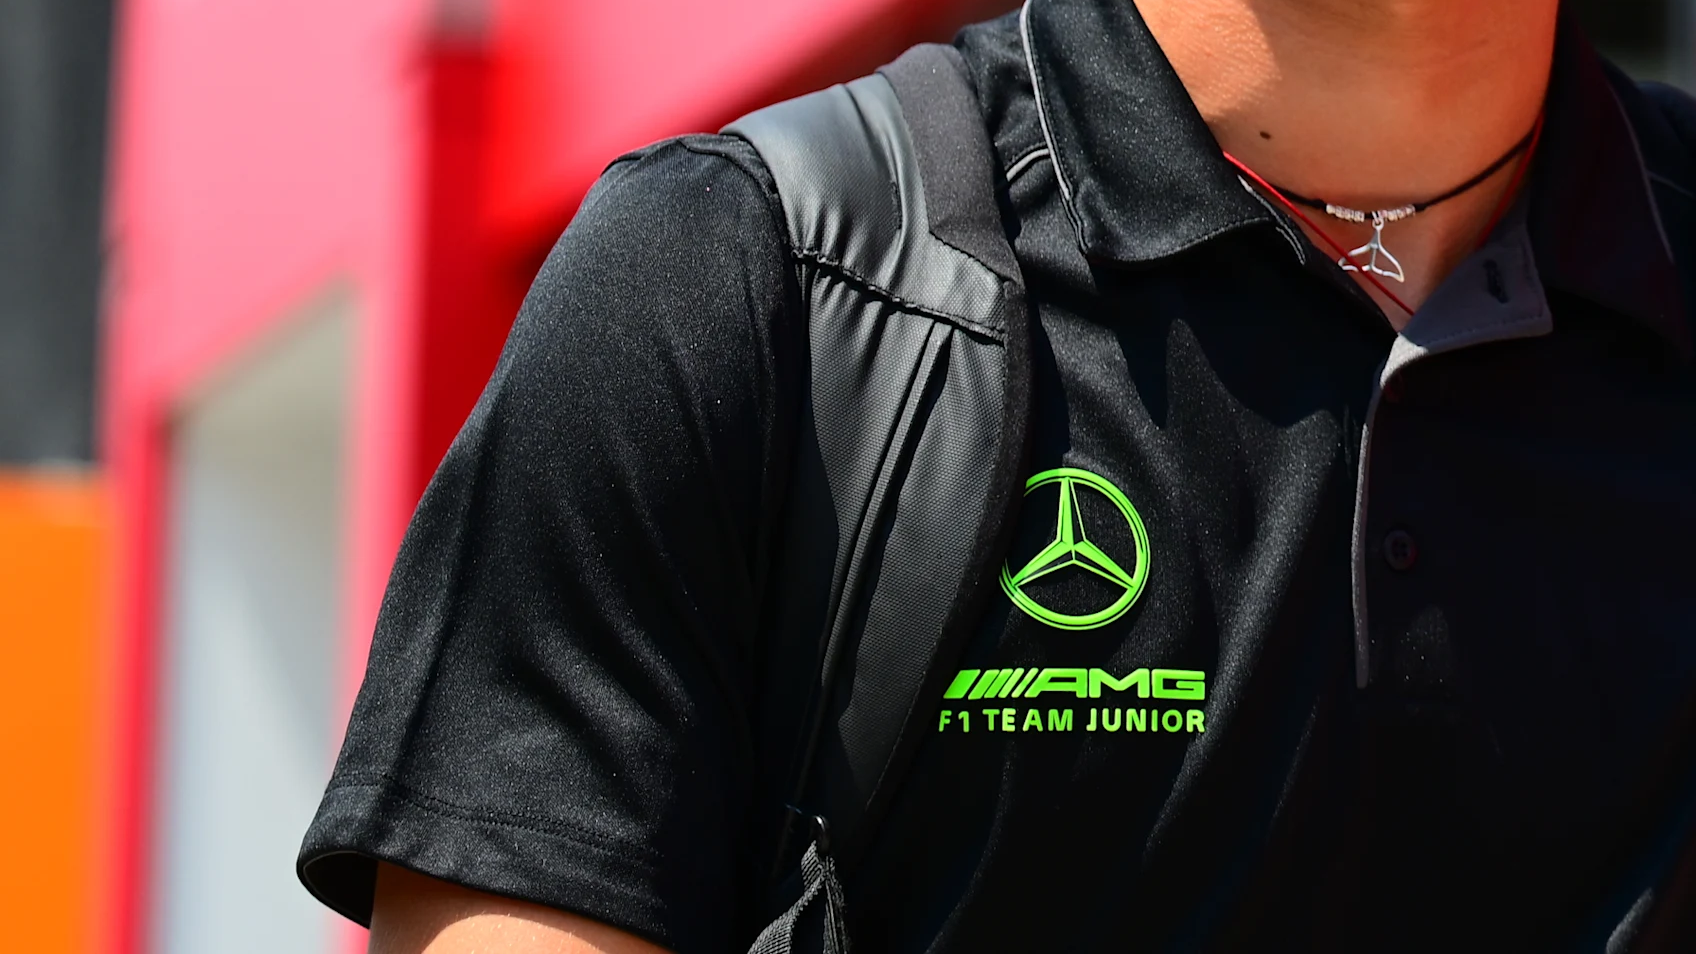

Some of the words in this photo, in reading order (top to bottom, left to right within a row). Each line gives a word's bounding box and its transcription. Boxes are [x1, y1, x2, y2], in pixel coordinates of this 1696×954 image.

[1024, 667, 1206, 701] AMG
[938, 709, 970, 733] F1
[982, 707, 1074, 732] TEAM
[1086, 707, 1206, 733] JUNIOR
